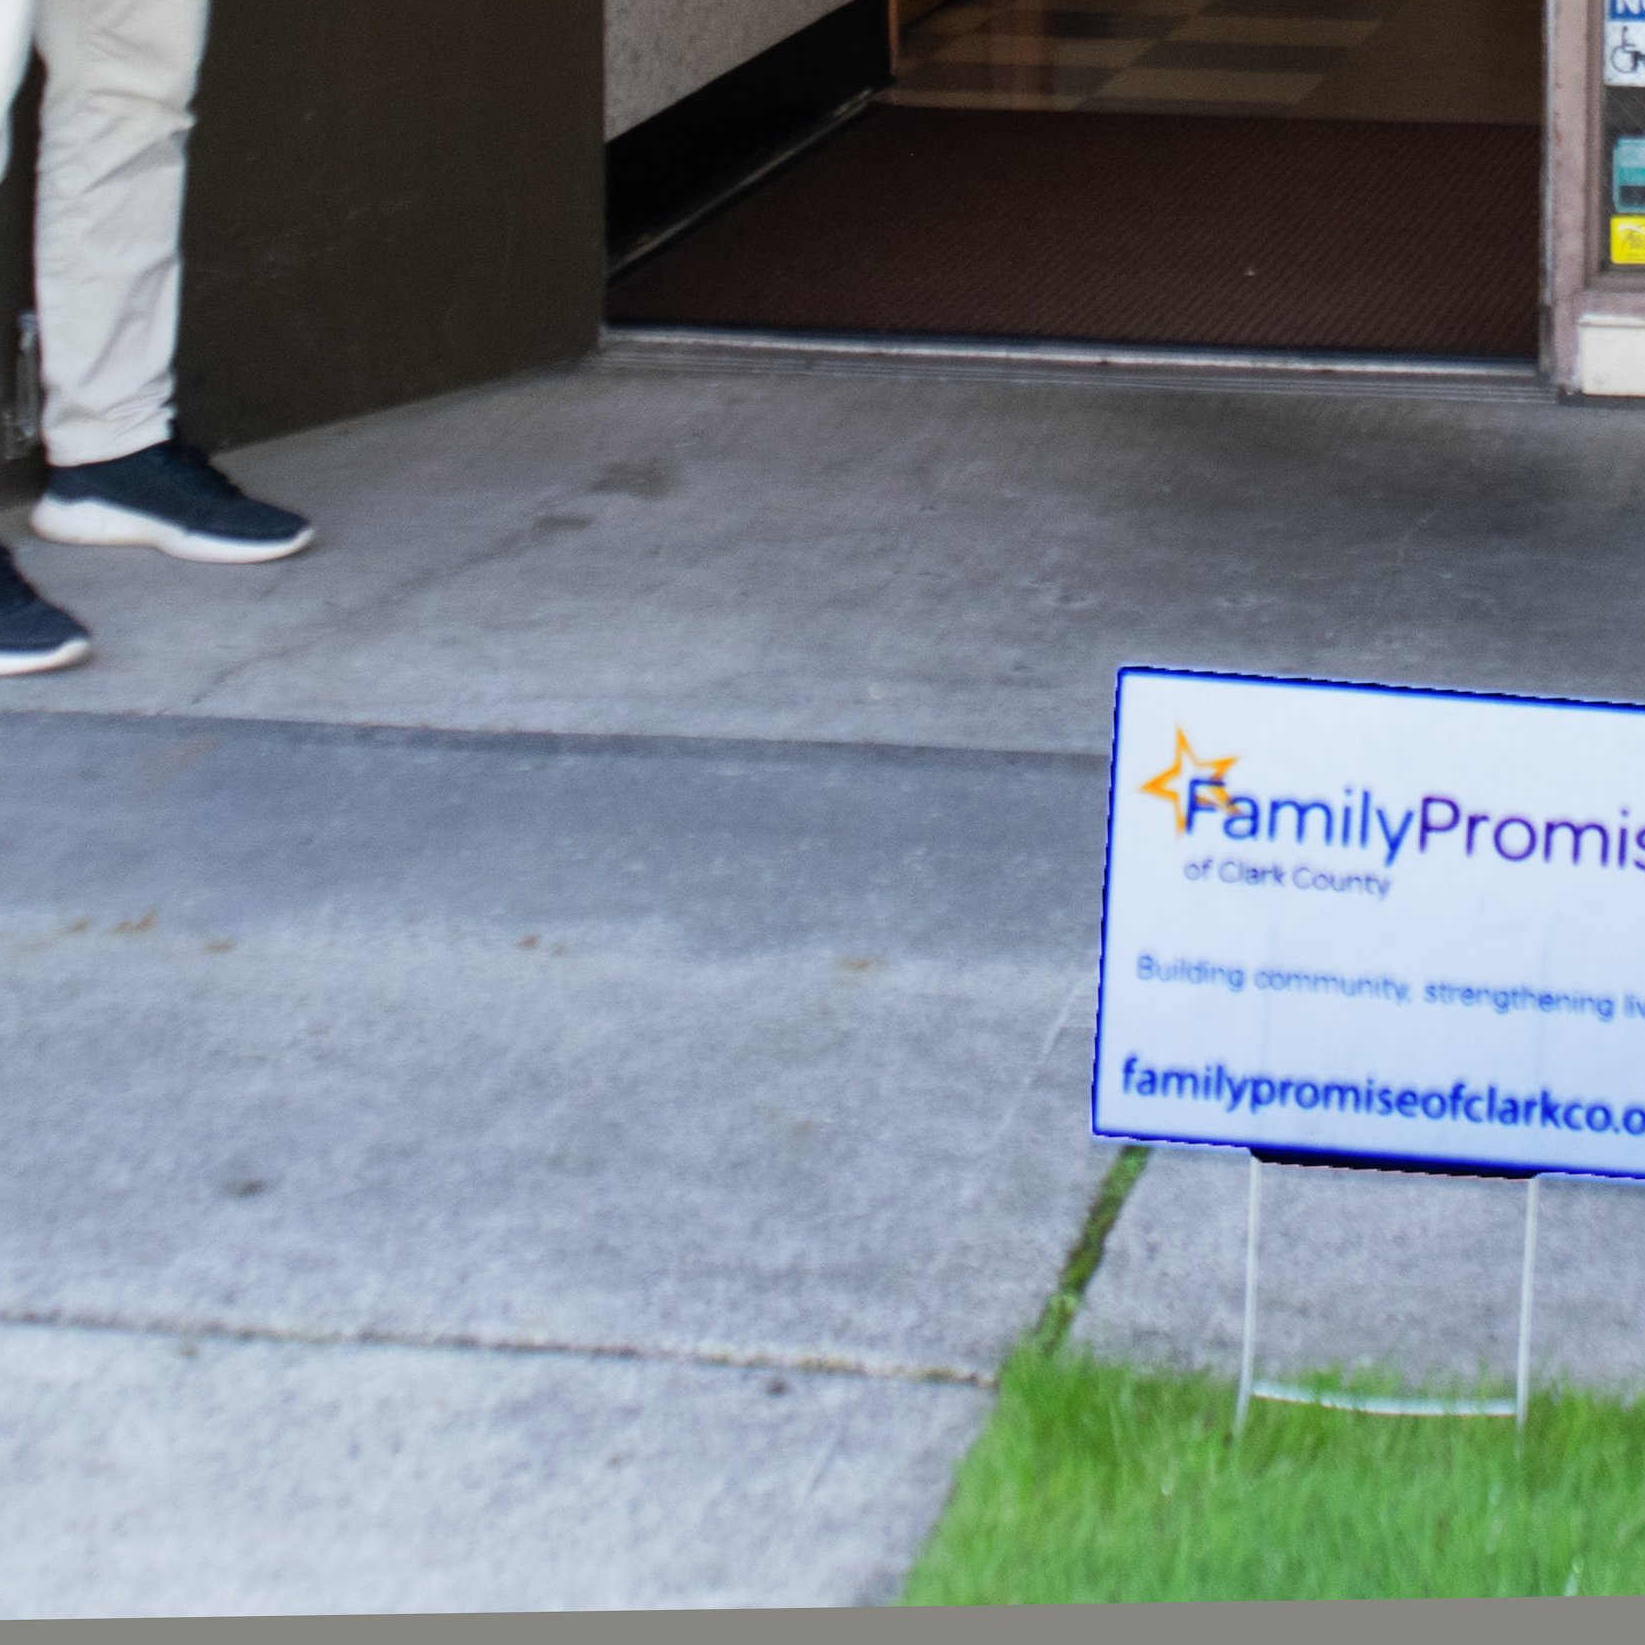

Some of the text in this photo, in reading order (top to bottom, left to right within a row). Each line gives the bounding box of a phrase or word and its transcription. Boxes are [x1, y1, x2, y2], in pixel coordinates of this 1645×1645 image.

[1182, 858, 1392, 902] of Clark County
[1137, 955, 1245, 993] Building
[1254, 970, 1413, 1006] community,
[1423, 983, 1616, 1023] strengthening
